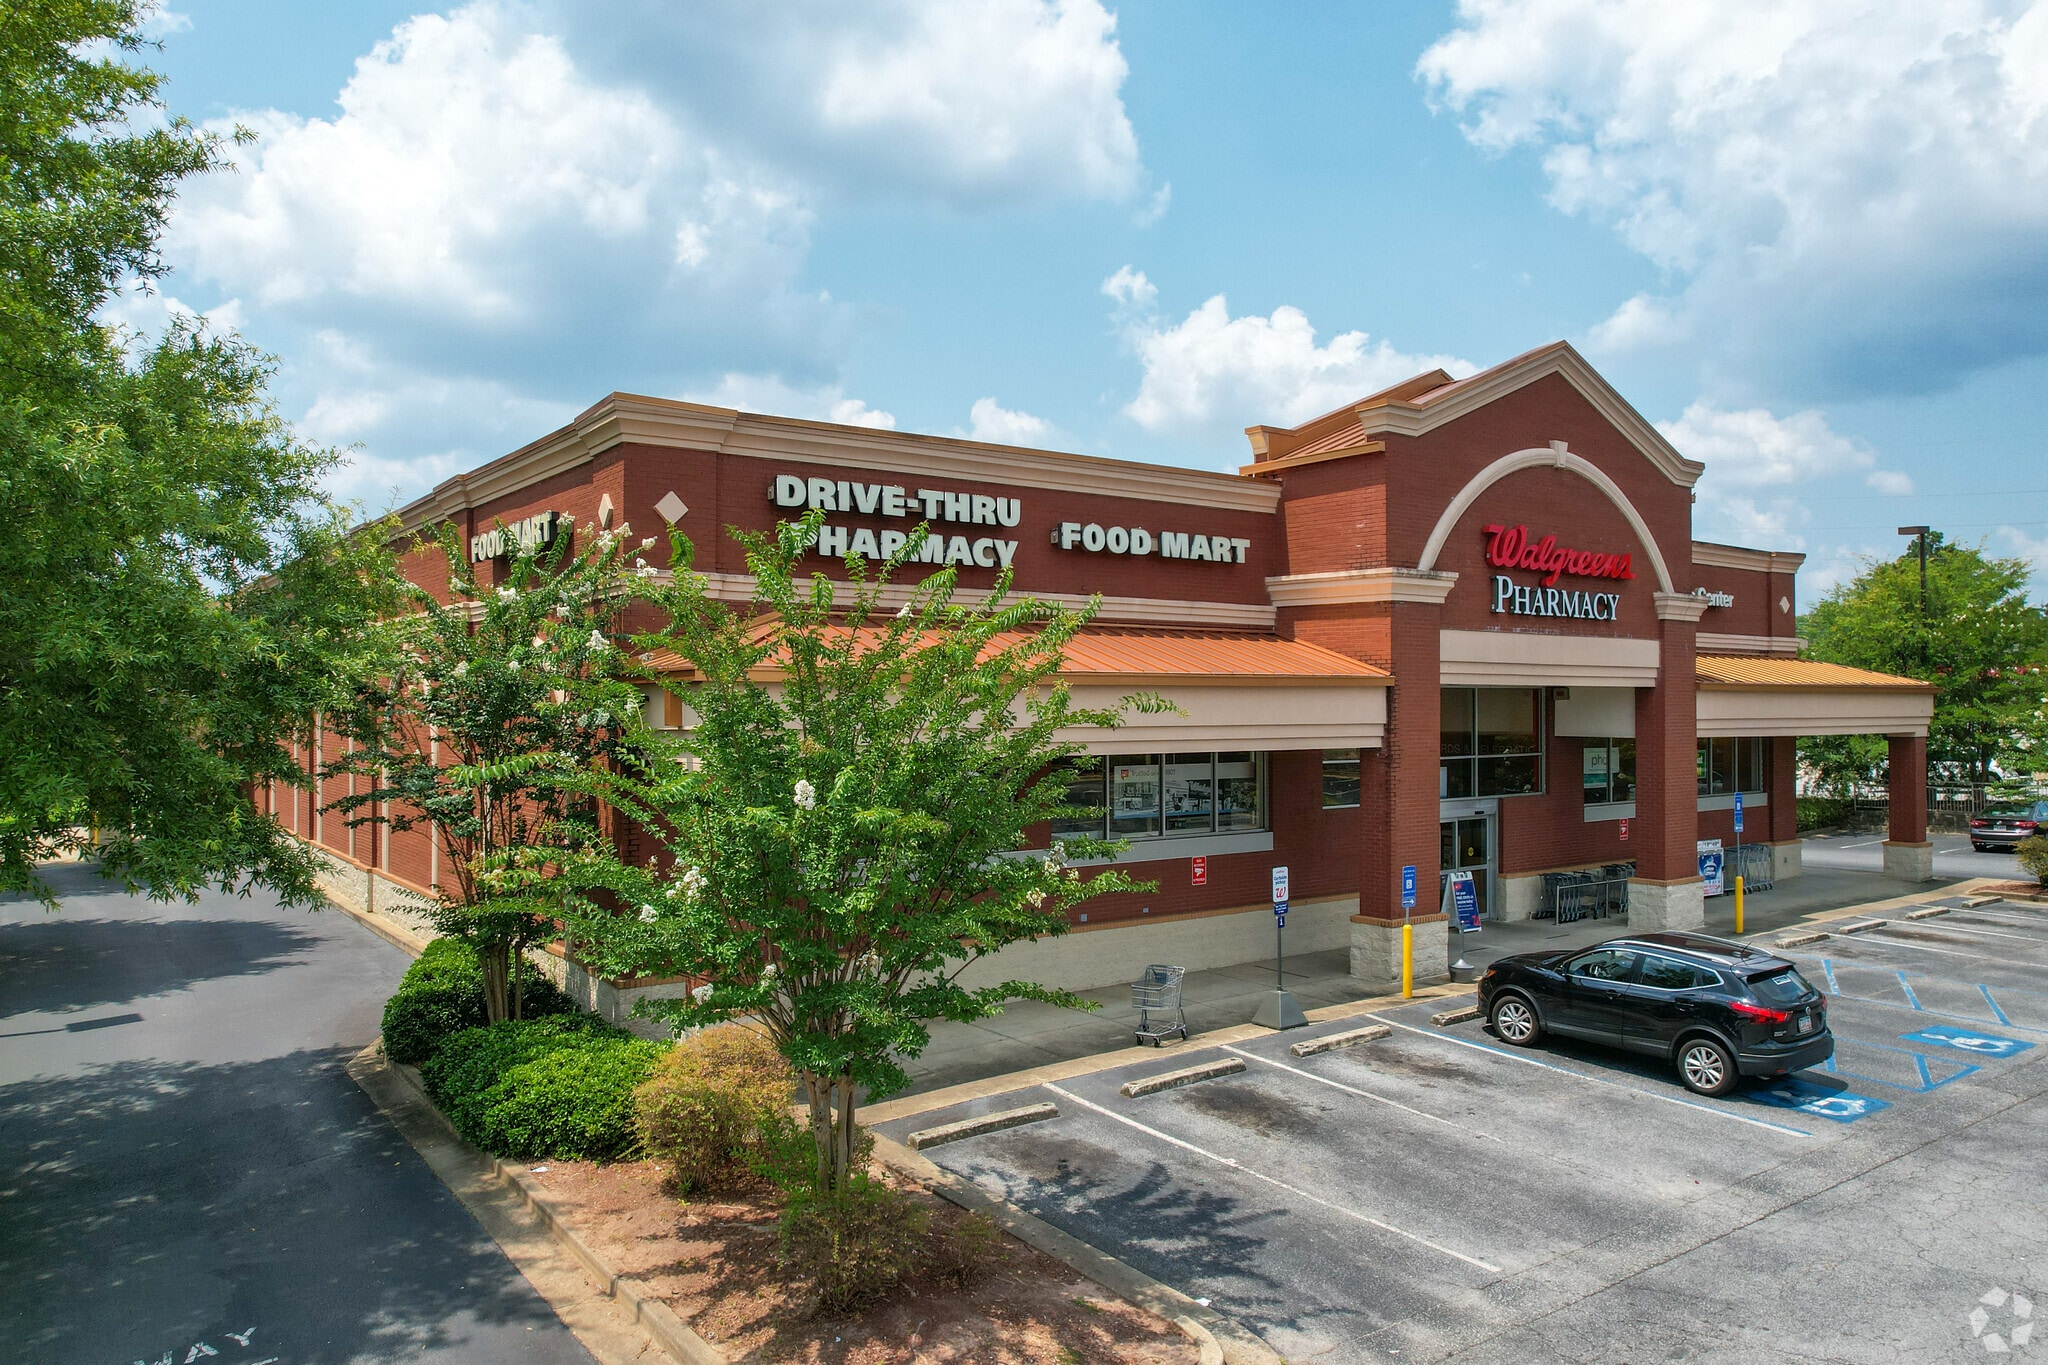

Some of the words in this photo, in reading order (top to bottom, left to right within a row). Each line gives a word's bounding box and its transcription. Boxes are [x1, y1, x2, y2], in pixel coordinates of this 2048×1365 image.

[775, 474, 1021, 527] DRIVE-THRU
[471, 528, 505, 563] FOOD
[1061, 522, 1152, 555] FOOD
[1158, 532, 1251, 564] MART
[1484, 524, 1637, 587] Walgreens
[1495, 575, 1620, 620] PHARMACY
